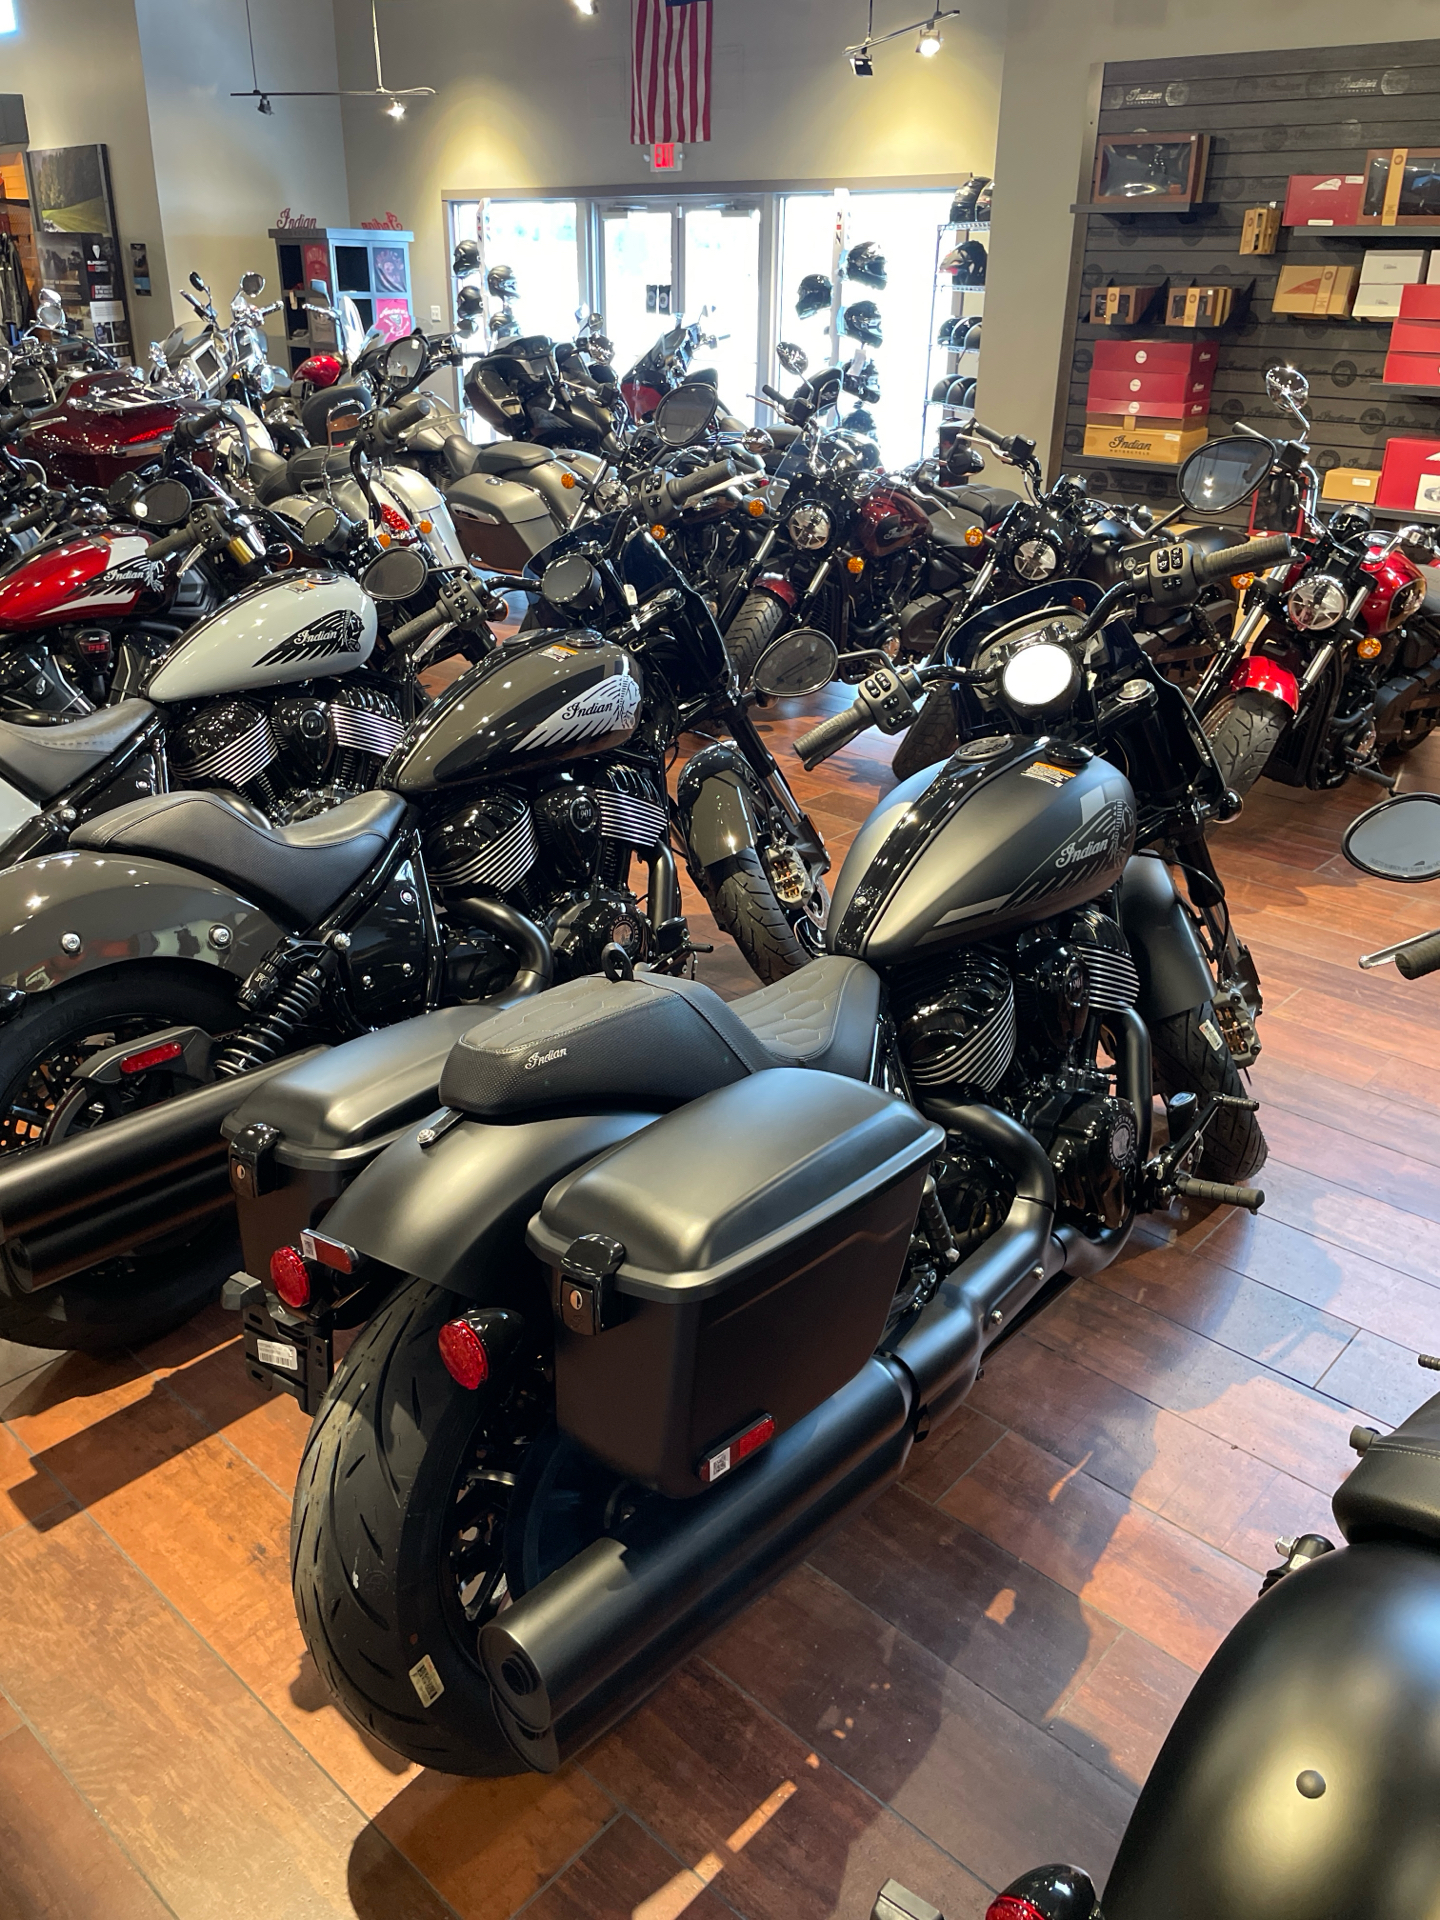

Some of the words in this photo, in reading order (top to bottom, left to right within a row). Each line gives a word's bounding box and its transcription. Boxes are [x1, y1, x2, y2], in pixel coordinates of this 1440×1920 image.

[654, 143, 675, 168] EXIT
[276, 208, 317, 230] Indian
[1108, 434, 1152, 451] Indian
[103, 569, 145, 581] Indian
[293, 629, 338, 645] Indian
[561, 701, 613, 721] Indian
[576, 808, 592, 820] 1901
[1055, 841, 1109, 869] Indian
[524, 1047, 568, 1070] Indian
